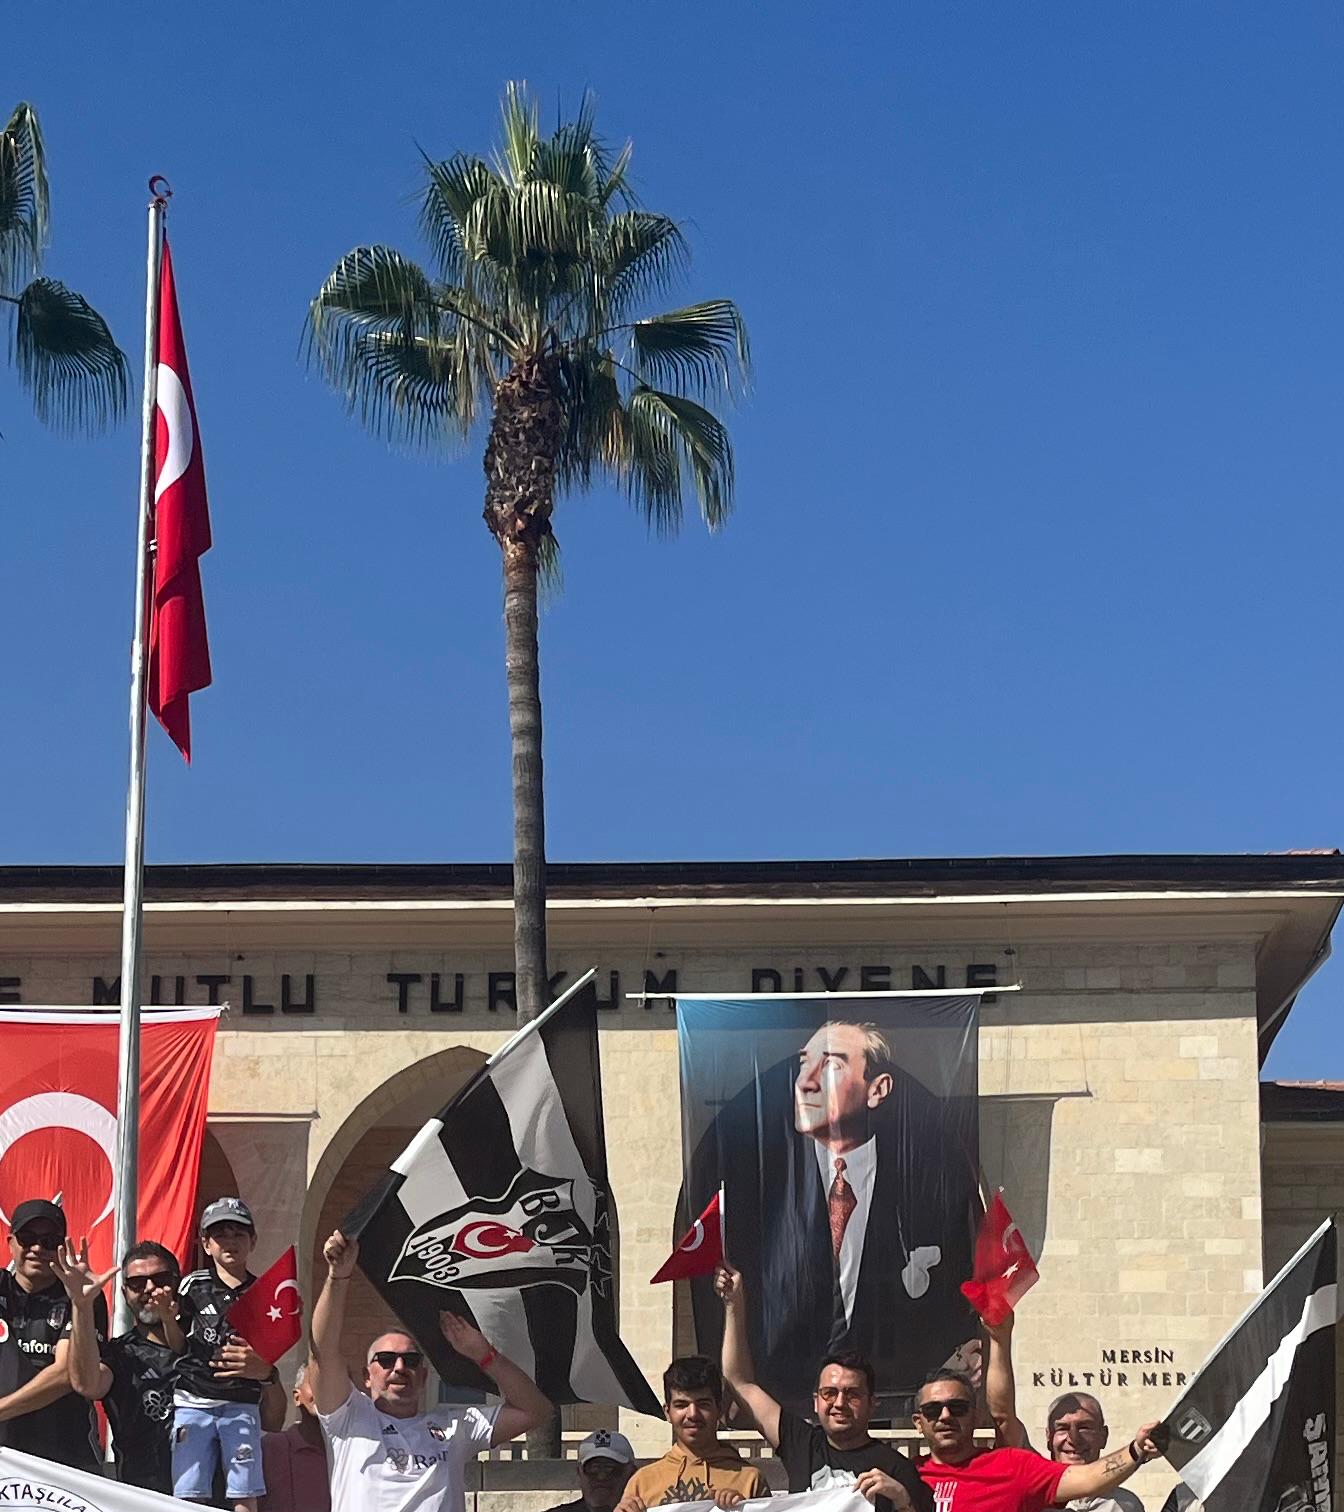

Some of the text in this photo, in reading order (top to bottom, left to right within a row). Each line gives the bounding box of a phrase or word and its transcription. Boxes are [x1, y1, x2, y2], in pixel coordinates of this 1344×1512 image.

[92, 973, 315, 1015] MUTLU
[751, 963, 997, 1004] DİYENE
[410, 1235, 461, 1282] 1903
[1101, 1347, 1175, 1364] MERSİN
[1032, 1367, 1129, 1388] KÜLTÜR
